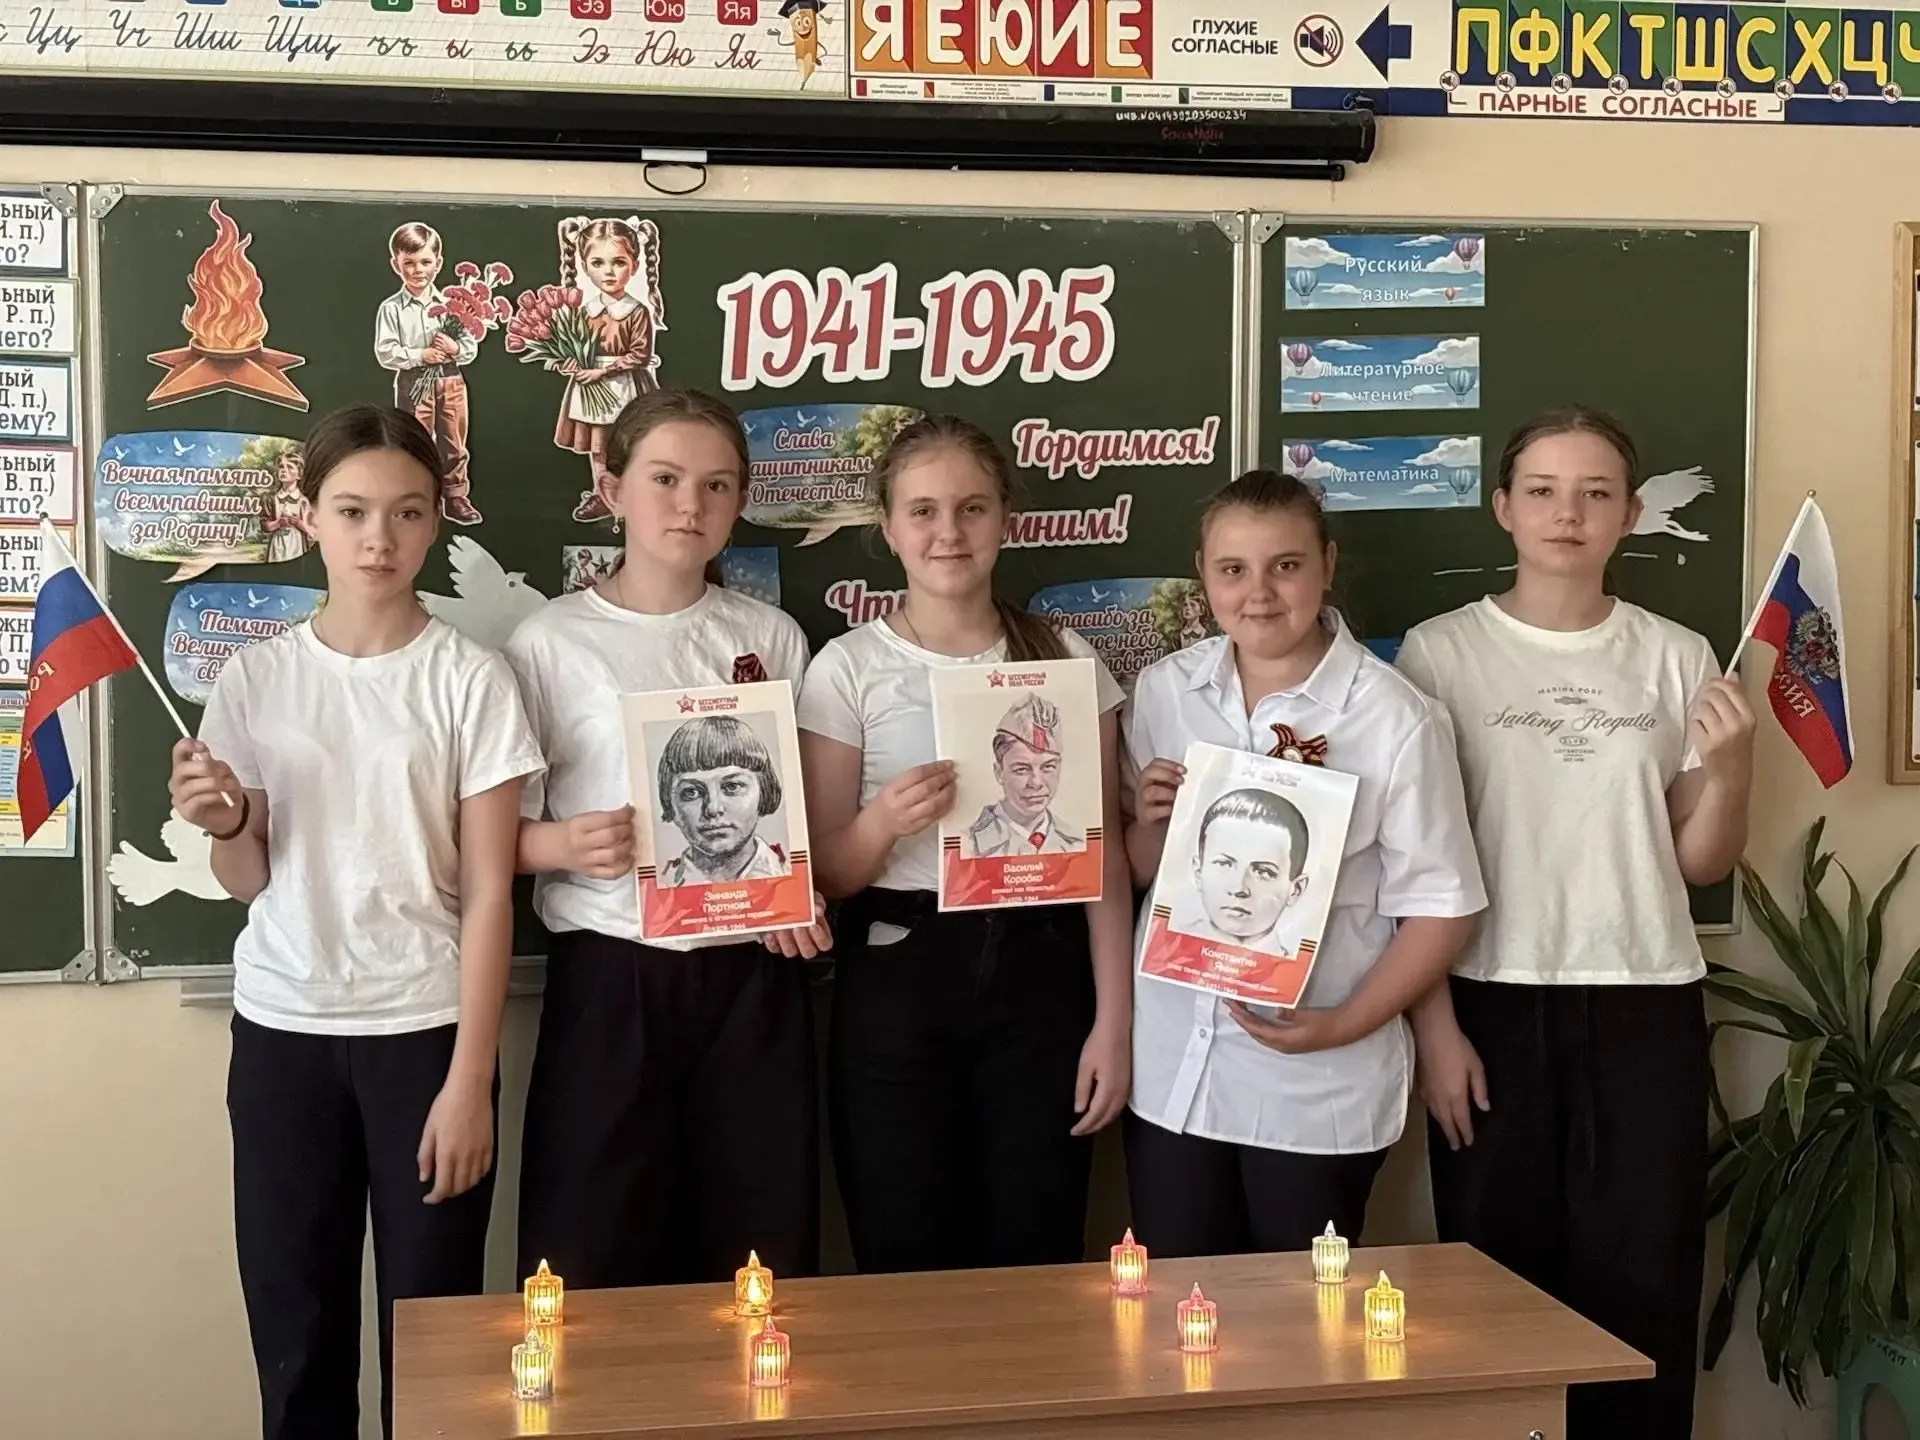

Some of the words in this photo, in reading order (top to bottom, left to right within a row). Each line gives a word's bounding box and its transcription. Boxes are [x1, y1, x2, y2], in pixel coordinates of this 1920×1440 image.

[723, 1, 752, 20] Яя
[25, 7, 82, 55] Цц
[108, 8, 152, 48] Чч
[173, 11, 242, 52] Шш
[264, 14, 342, 62] Щщ
[572, 26, 611, 64] Ээ
[634, 28, 696, 69] Юю
[713, 31, 762, 70] Яя
[1191, 18, 1258, 37] ГЛУХИЕ
[1170, 36, 1280, 56] СОГЛАСНЫЕ
[1478, 92, 1588, 115] ПАРНЫЕ
[1601, 94, 1759, 119] СОГЛАСНЫЕ
[1344, 255, 1423, 277] Русский
[1361, 288, 1411, 302] язык
[0, 329, 54, 348] его?
[722, 268, 1111, 386] 1941-1945
[1320, 361, 1445, 380] Литературное
[1352, 389, 1414, 402] чтение
[774, 427, 836, 452] Слава
[1014, 418, 1218, 476] Гордимся!
[102, 460, 183, 484] Вечная
[184, 468, 273, 487] память
[1330, 467, 1440, 484] Математика
[115, 488, 170, 512] всем
[171, 490, 262, 513] павшим
[751, 478, 865, 504] Отечества!
[131, 521, 162, 546] за
[161, 517, 248, 547] Родину!
[1127, 609, 1156, 631] за
[1116, 625, 1163, 650] небо
[1483, 705, 1565, 737] Sailing
[1571, 707, 1657, 737] Regatta
